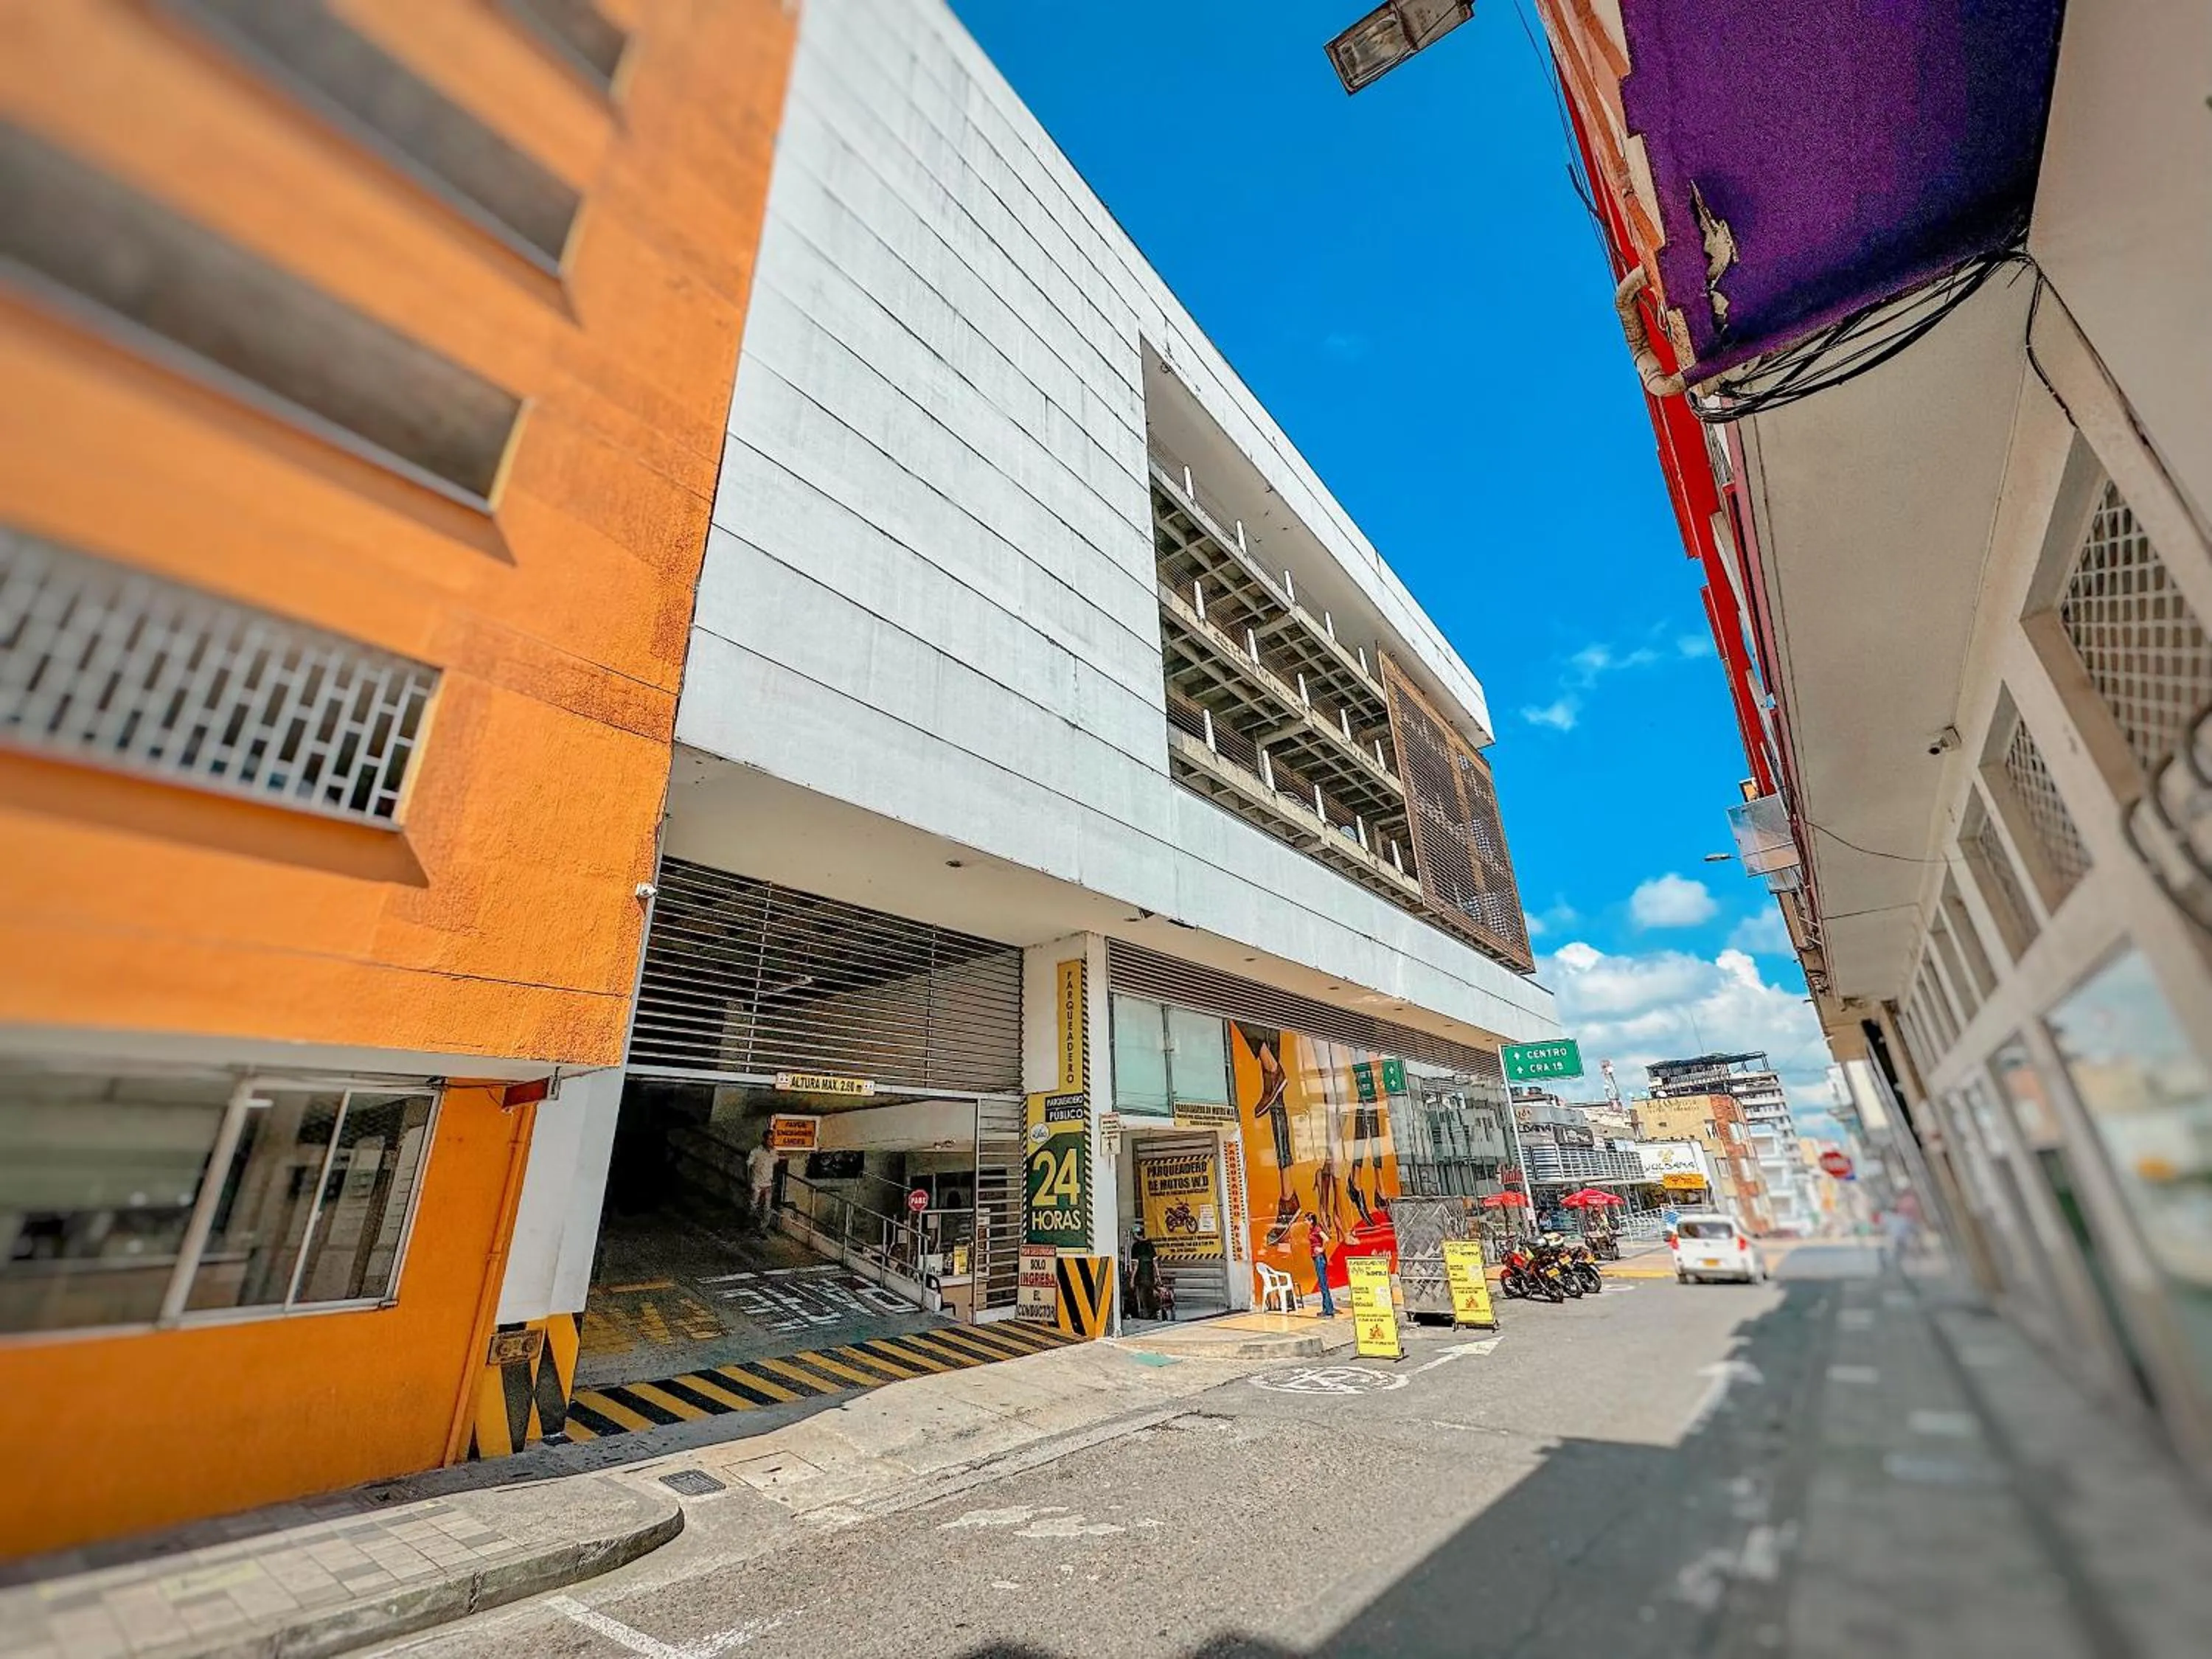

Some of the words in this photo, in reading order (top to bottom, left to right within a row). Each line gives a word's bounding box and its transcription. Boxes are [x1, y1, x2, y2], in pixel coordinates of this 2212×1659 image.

[1065, 970, 1075, 1084] PARQUEADERO
[1526, 1047, 1567, 1059] CENTRO
[1530, 1063, 1551, 1074] CRA
[790, 1075, 820, 1089] ALTURA
[1046, 1094, 1084, 1107] PARQUEADERO
[1032, 1147, 1081, 1207] 24
[1147, 1162, 1207, 1178] PARQUEADERO
[1160, 1178, 1190, 1191] MOTOS
[1032, 1208, 1082, 1231] HORAS
[1030, 1259, 1046, 1270] SOLO
[1020, 1272, 1055, 1287] INGRESA
[1033, 1290, 1041, 1301] EL
[1017, 1304, 1055, 1318] CONDUCTOR
